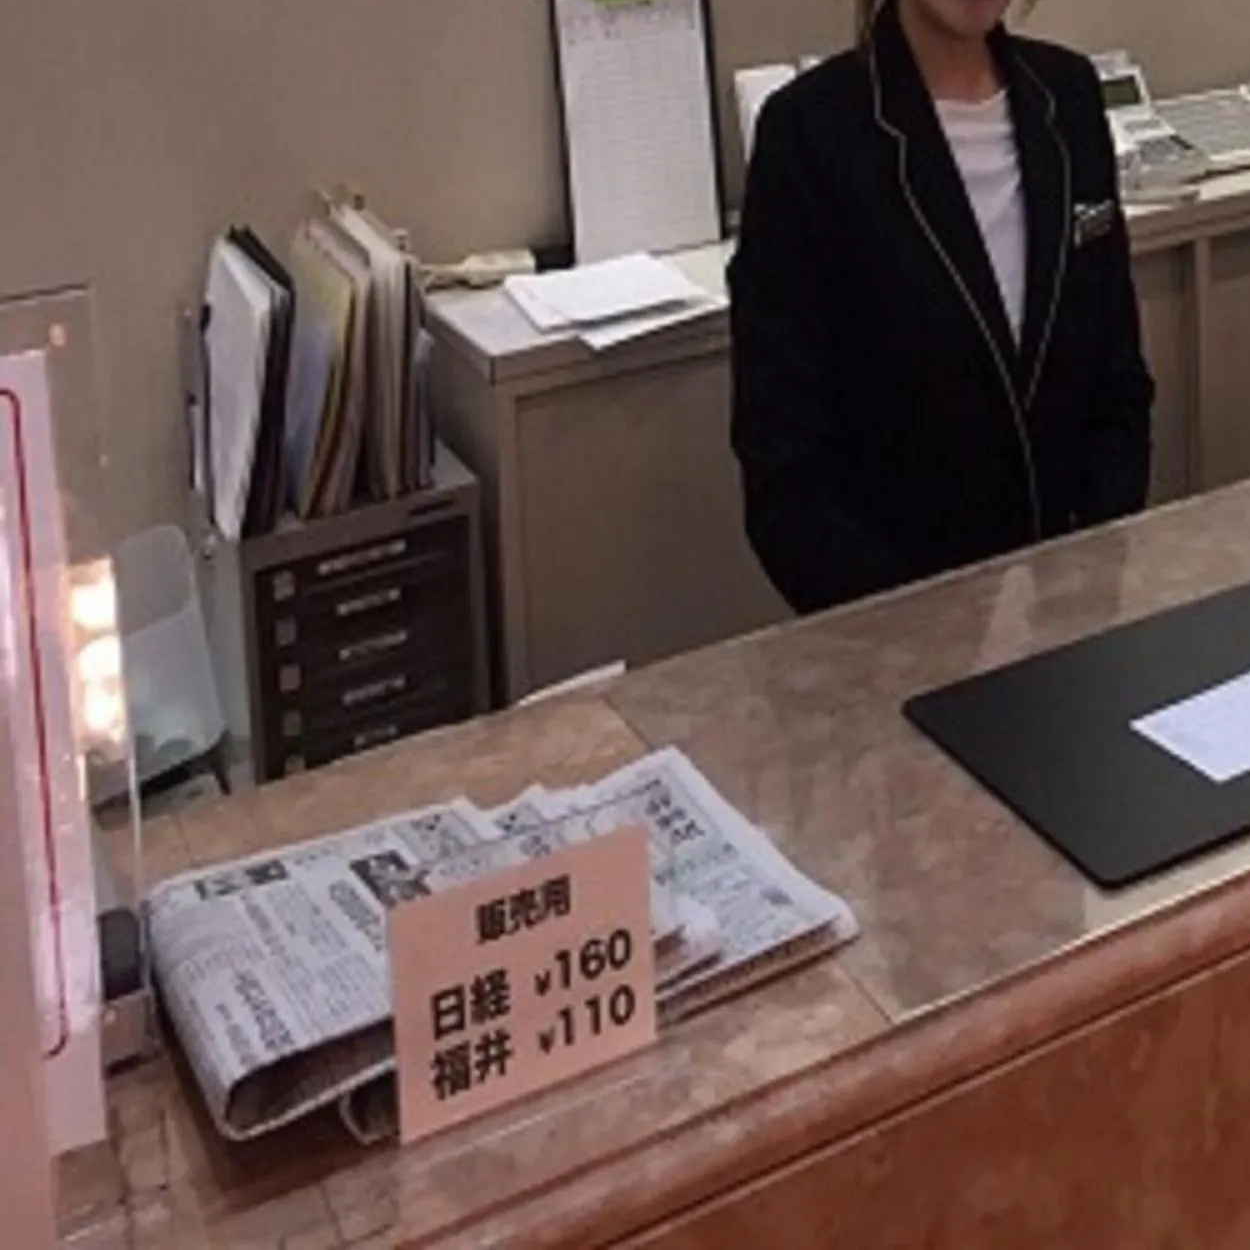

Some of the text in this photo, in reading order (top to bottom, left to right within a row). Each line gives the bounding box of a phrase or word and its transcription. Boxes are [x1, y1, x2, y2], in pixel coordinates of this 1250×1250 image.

[475, 873, 571, 944] 販売用
[430, 969, 511, 1040] 日経
[431, 1030, 513, 1101] 福井
